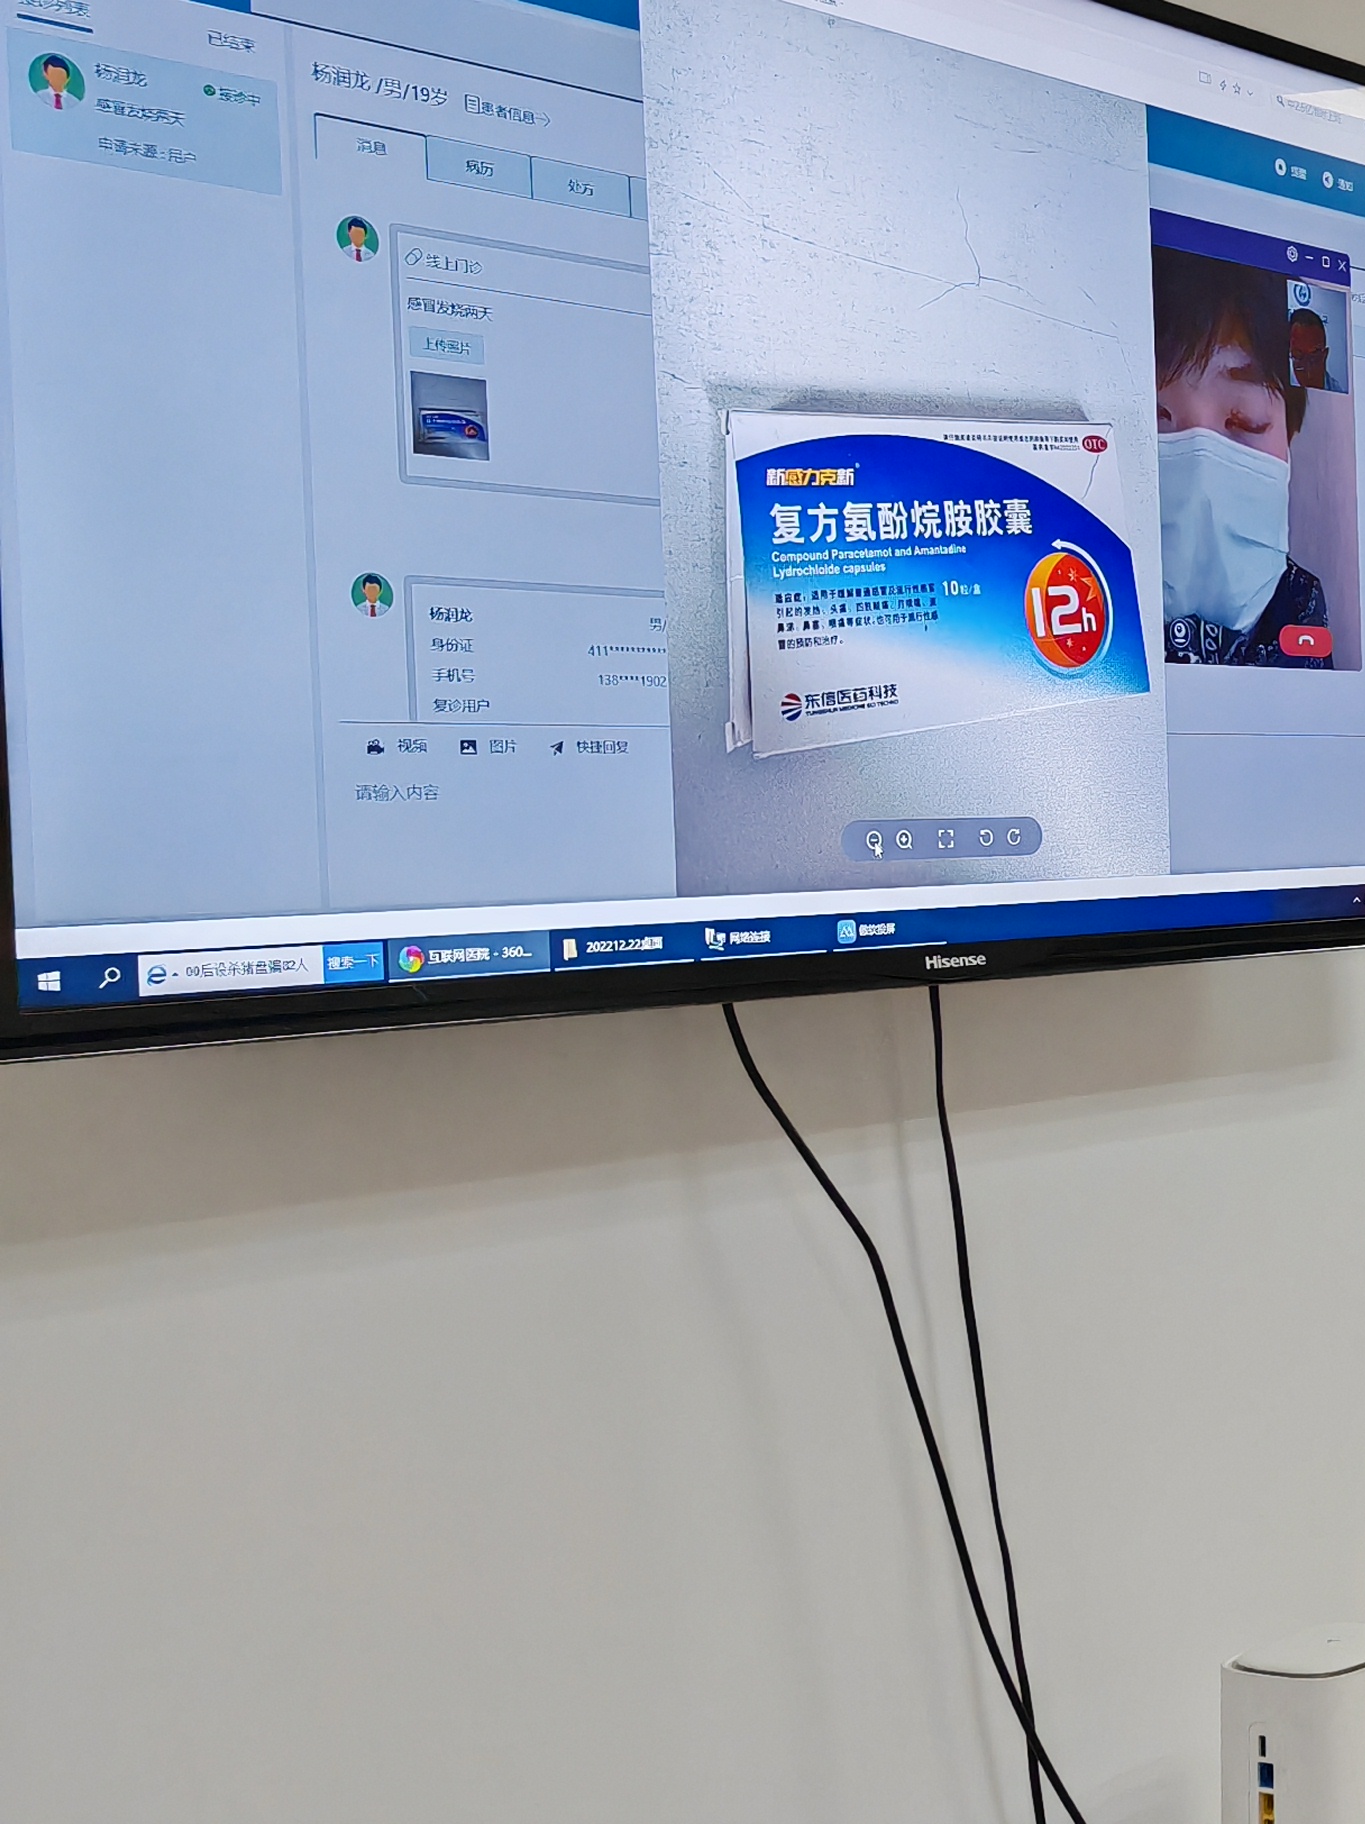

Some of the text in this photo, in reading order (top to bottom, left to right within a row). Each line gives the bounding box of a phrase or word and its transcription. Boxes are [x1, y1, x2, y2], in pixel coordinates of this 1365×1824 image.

[311, 61, 371, 92] 杨润龙
[481, 101, 535, 125] 患者信息
[357, 137, 388, 155] 消息
[465, 159, 494, 177] 病历
[568, 179, 595, 196] 处方
[426, 253, 482, 274] 线上门诊
[407, 297, 493, 321] 感冒发烧两天
[423, 337, 471, 355] 上传照片
[1084, 436, 1106, 452] OTC
[769, 498, 1033, 544] 复方氨酚烷胺胶囊
[771, 548, 829, 564] Compound
[894, 547, 912, 557] and
[842, 562, 886, 575] capsules
[429, 607, 473, 623] 杨润龙
[1030, 585, 1096, 638] 12h
[431, 638, 474, 653] 身份证
[433, 668, 475, 683] 手机号
[433, 699, 490, 713] 复诊用户
[397, 738, 428, 753] 视频
[490, 740, 517, 753] 图片
[355, 784, 439, 801] 请输入内容
[327, 953, 380, 971] 搜索一下
[428, 947, 489, 964] 互联网医院
[925, 952, 987, 970] Hisense
